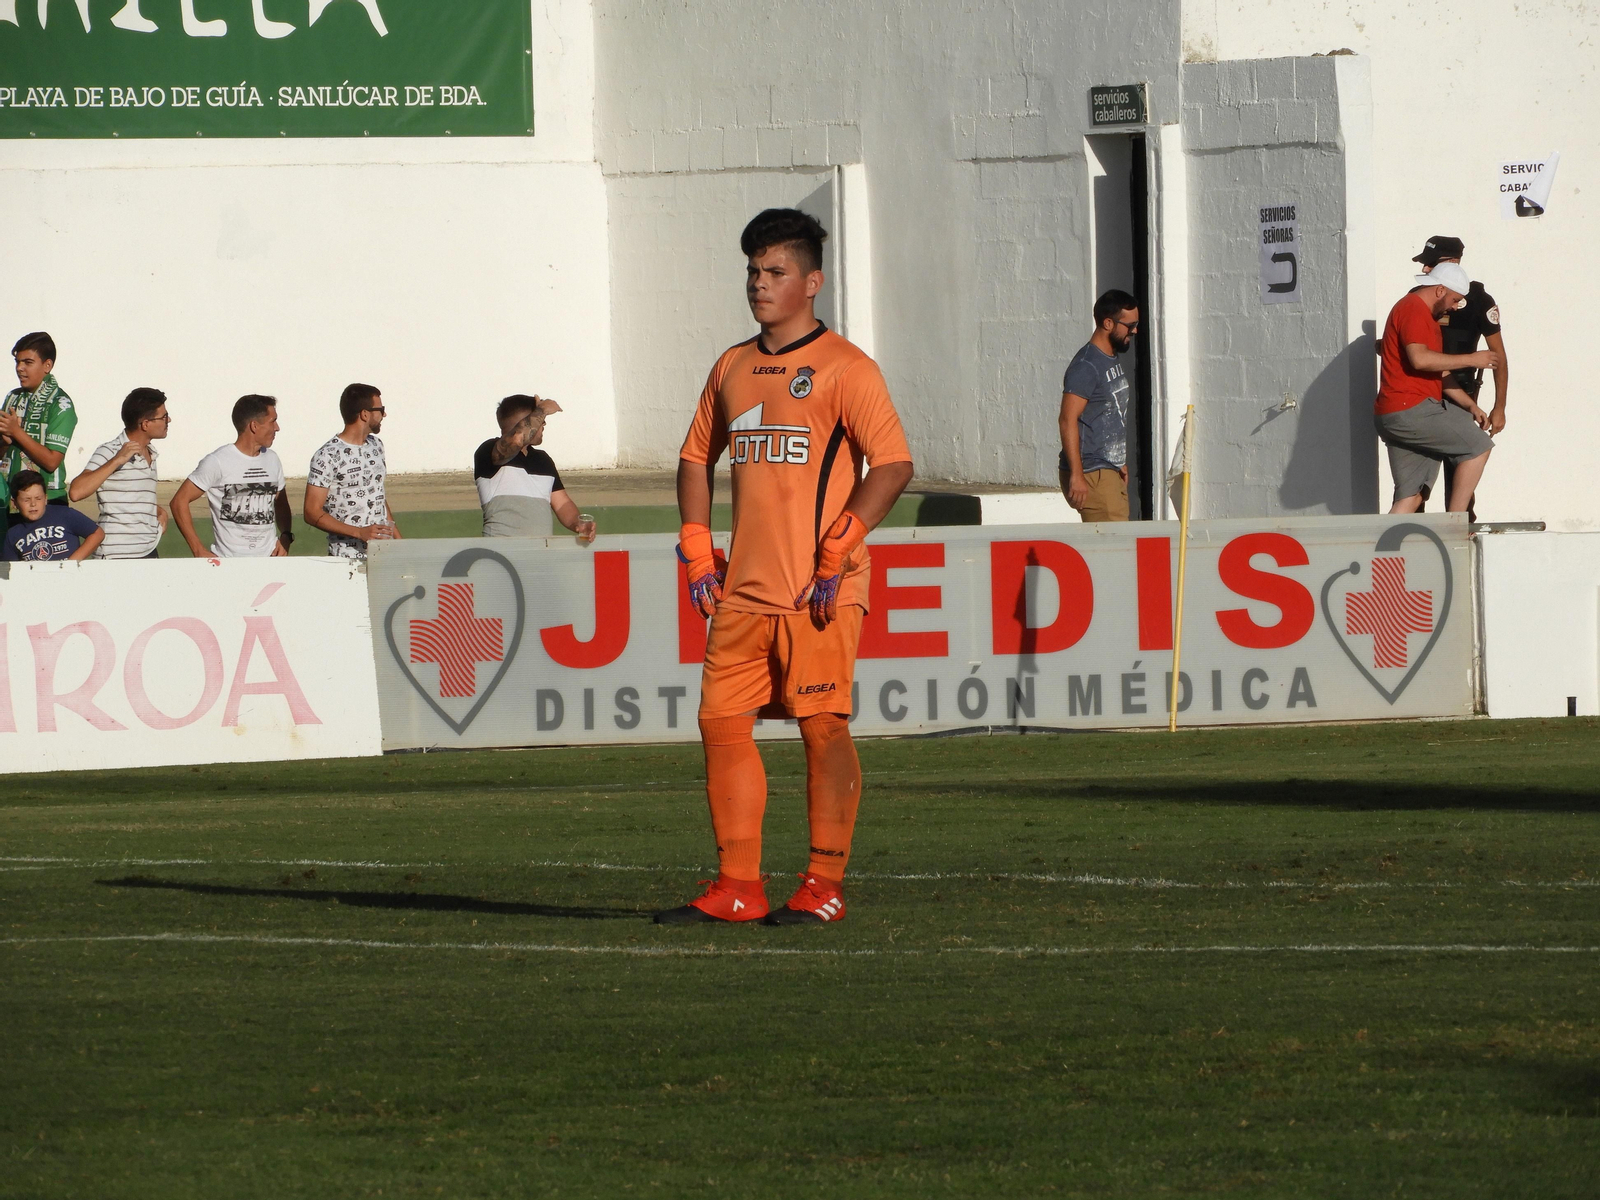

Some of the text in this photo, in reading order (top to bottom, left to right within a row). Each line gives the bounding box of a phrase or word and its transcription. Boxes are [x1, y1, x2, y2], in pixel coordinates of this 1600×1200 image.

[0, 80, 487, 107] PLAYA DE BAJO DE GUÍA SANLÚCAR DE BDA.
[1093, 89, 1129, 105] servicios
[1095, 105, 1137, 122] caballeros
[1499, 182, 1531, 193] CABA
[1260, 205, 1296, 223] SERVICIOS
[1263, 226, 1294, 244] SEÑORAS
[752, 366, 787, 375] LEGEA
[730, 434, 810, 465] OTUS
[15, 526, 65, 552] PARIS
[536, 660, 1317, 731] DISTCIÓN MÉDICA
[797, 682, 836, 695] LEGEA
